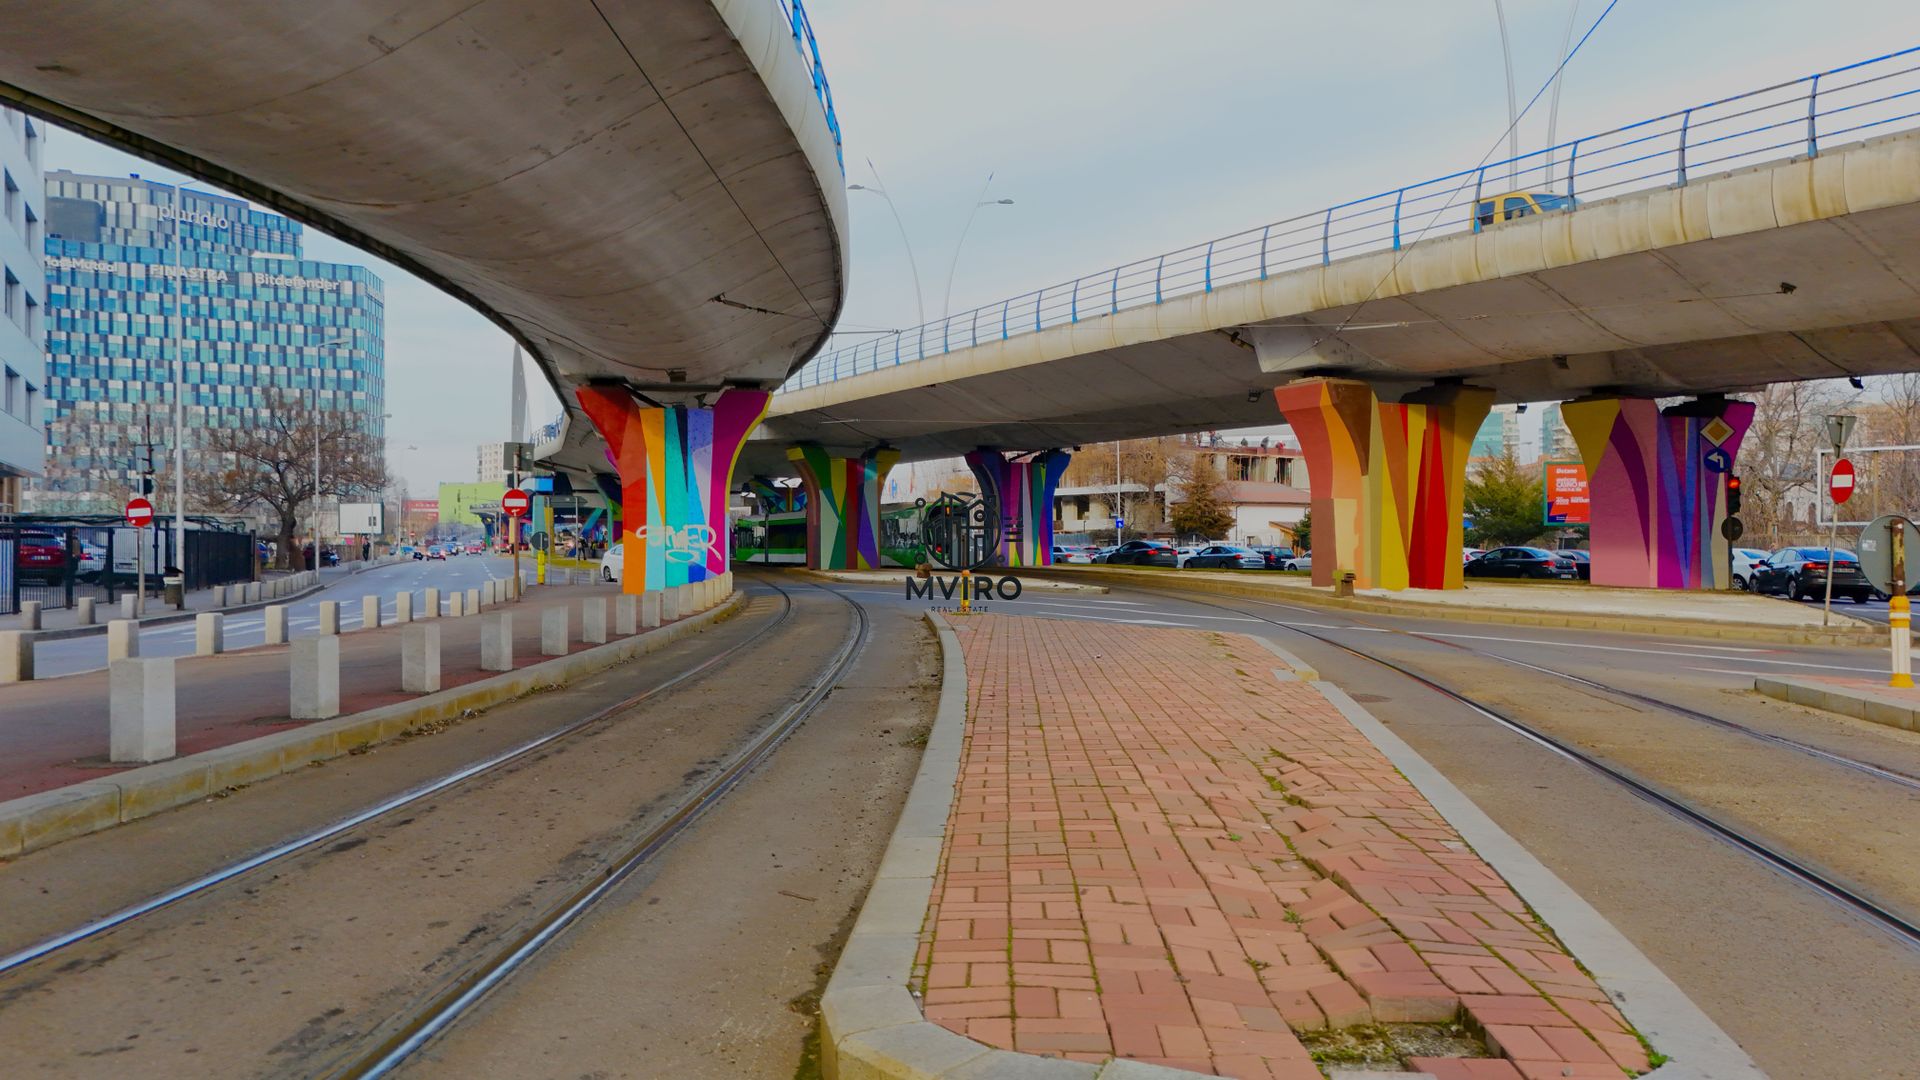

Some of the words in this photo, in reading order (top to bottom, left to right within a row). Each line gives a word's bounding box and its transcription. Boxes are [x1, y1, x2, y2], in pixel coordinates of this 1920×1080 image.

[158, 203, 228, 229] pluridio
[150, 264, 228, 281] FINASTRA
[254, 272, 339, 291] Bitdefender
